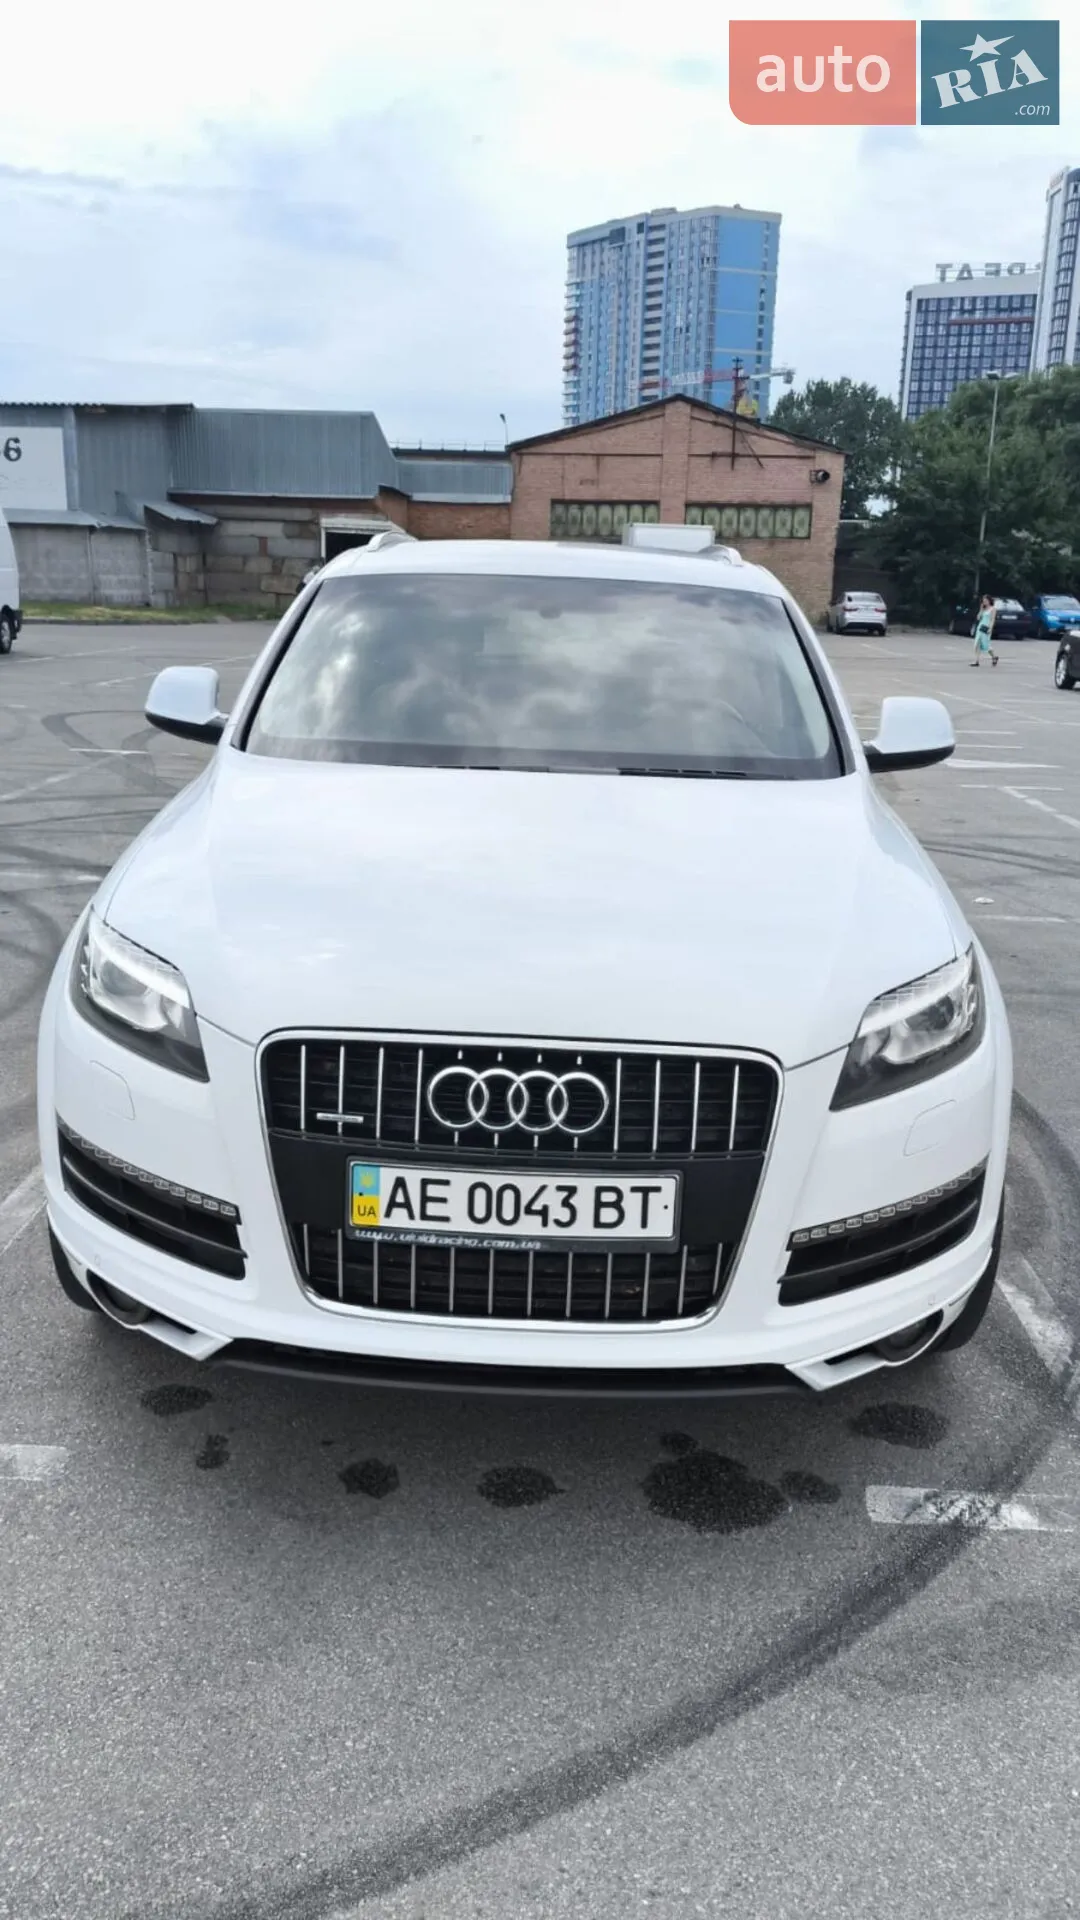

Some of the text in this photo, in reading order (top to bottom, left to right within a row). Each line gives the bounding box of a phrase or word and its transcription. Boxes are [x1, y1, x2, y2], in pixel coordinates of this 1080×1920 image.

[357, 1205, 377, 1217] UA
[384, 1176, 662, 1229] AE 0043 BT
